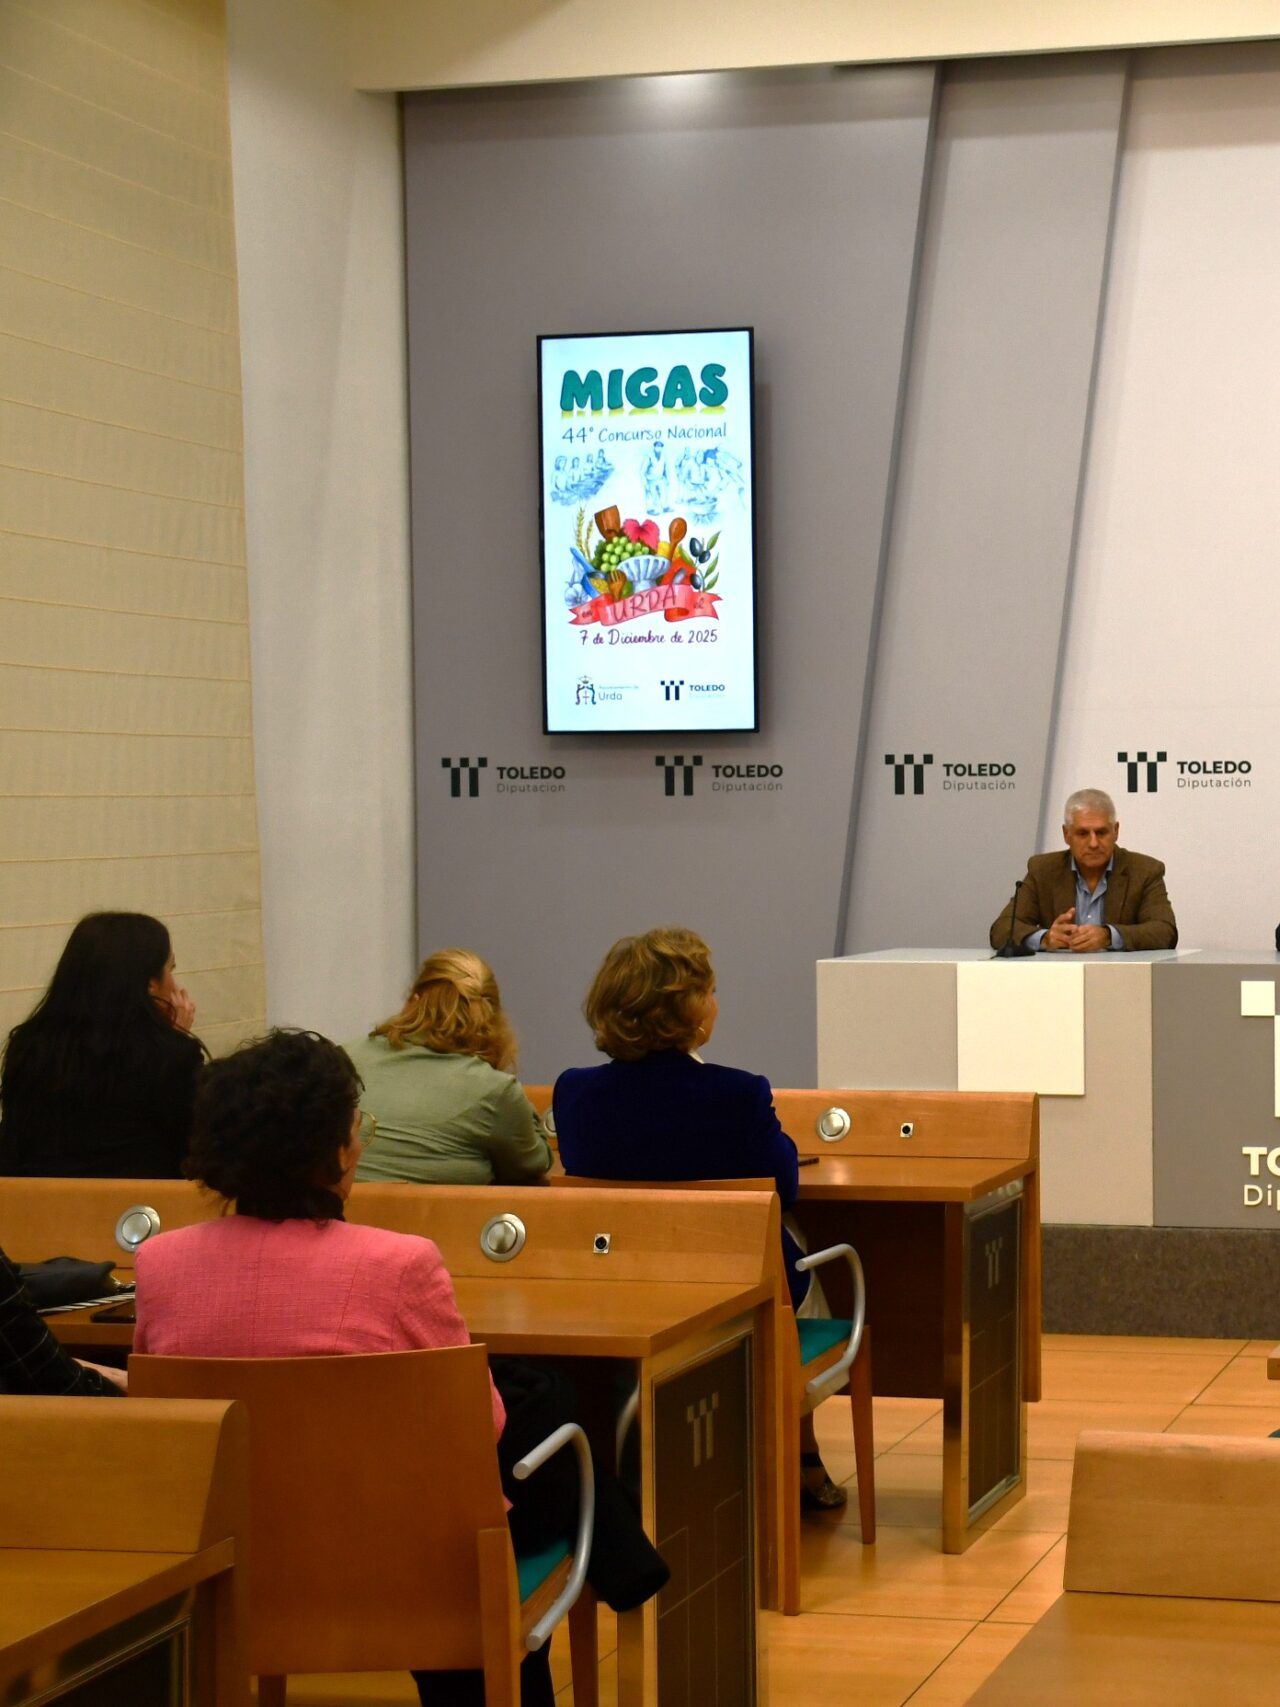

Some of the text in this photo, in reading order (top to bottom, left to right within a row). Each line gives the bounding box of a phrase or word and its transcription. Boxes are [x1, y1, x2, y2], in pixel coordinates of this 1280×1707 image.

[560, 363, 729, 412] MIGAS
[598, 427, 662, 443] Concurso
[667, 422, 727, 439] Nacional
[613, 584, 677, 622] URDA
[579, 629, 718, 645] 7 de Diciembre de 2025
[689, 684, 726, 692] TOLEDO
[598, 690, 623, 701] Urda
[496, 766, 566, 780] TOLEDO
[711, 764, 784, 779] TOLEDO
[943, 763, 1016, 777] TOLEDO
[1176, 760, 1252, 775] TOLEDO
[711, 781, 784, 793] Diputación
[943, 780, 1016, 792] Diputación
[1176, 777, 1252, 790] Diputación
